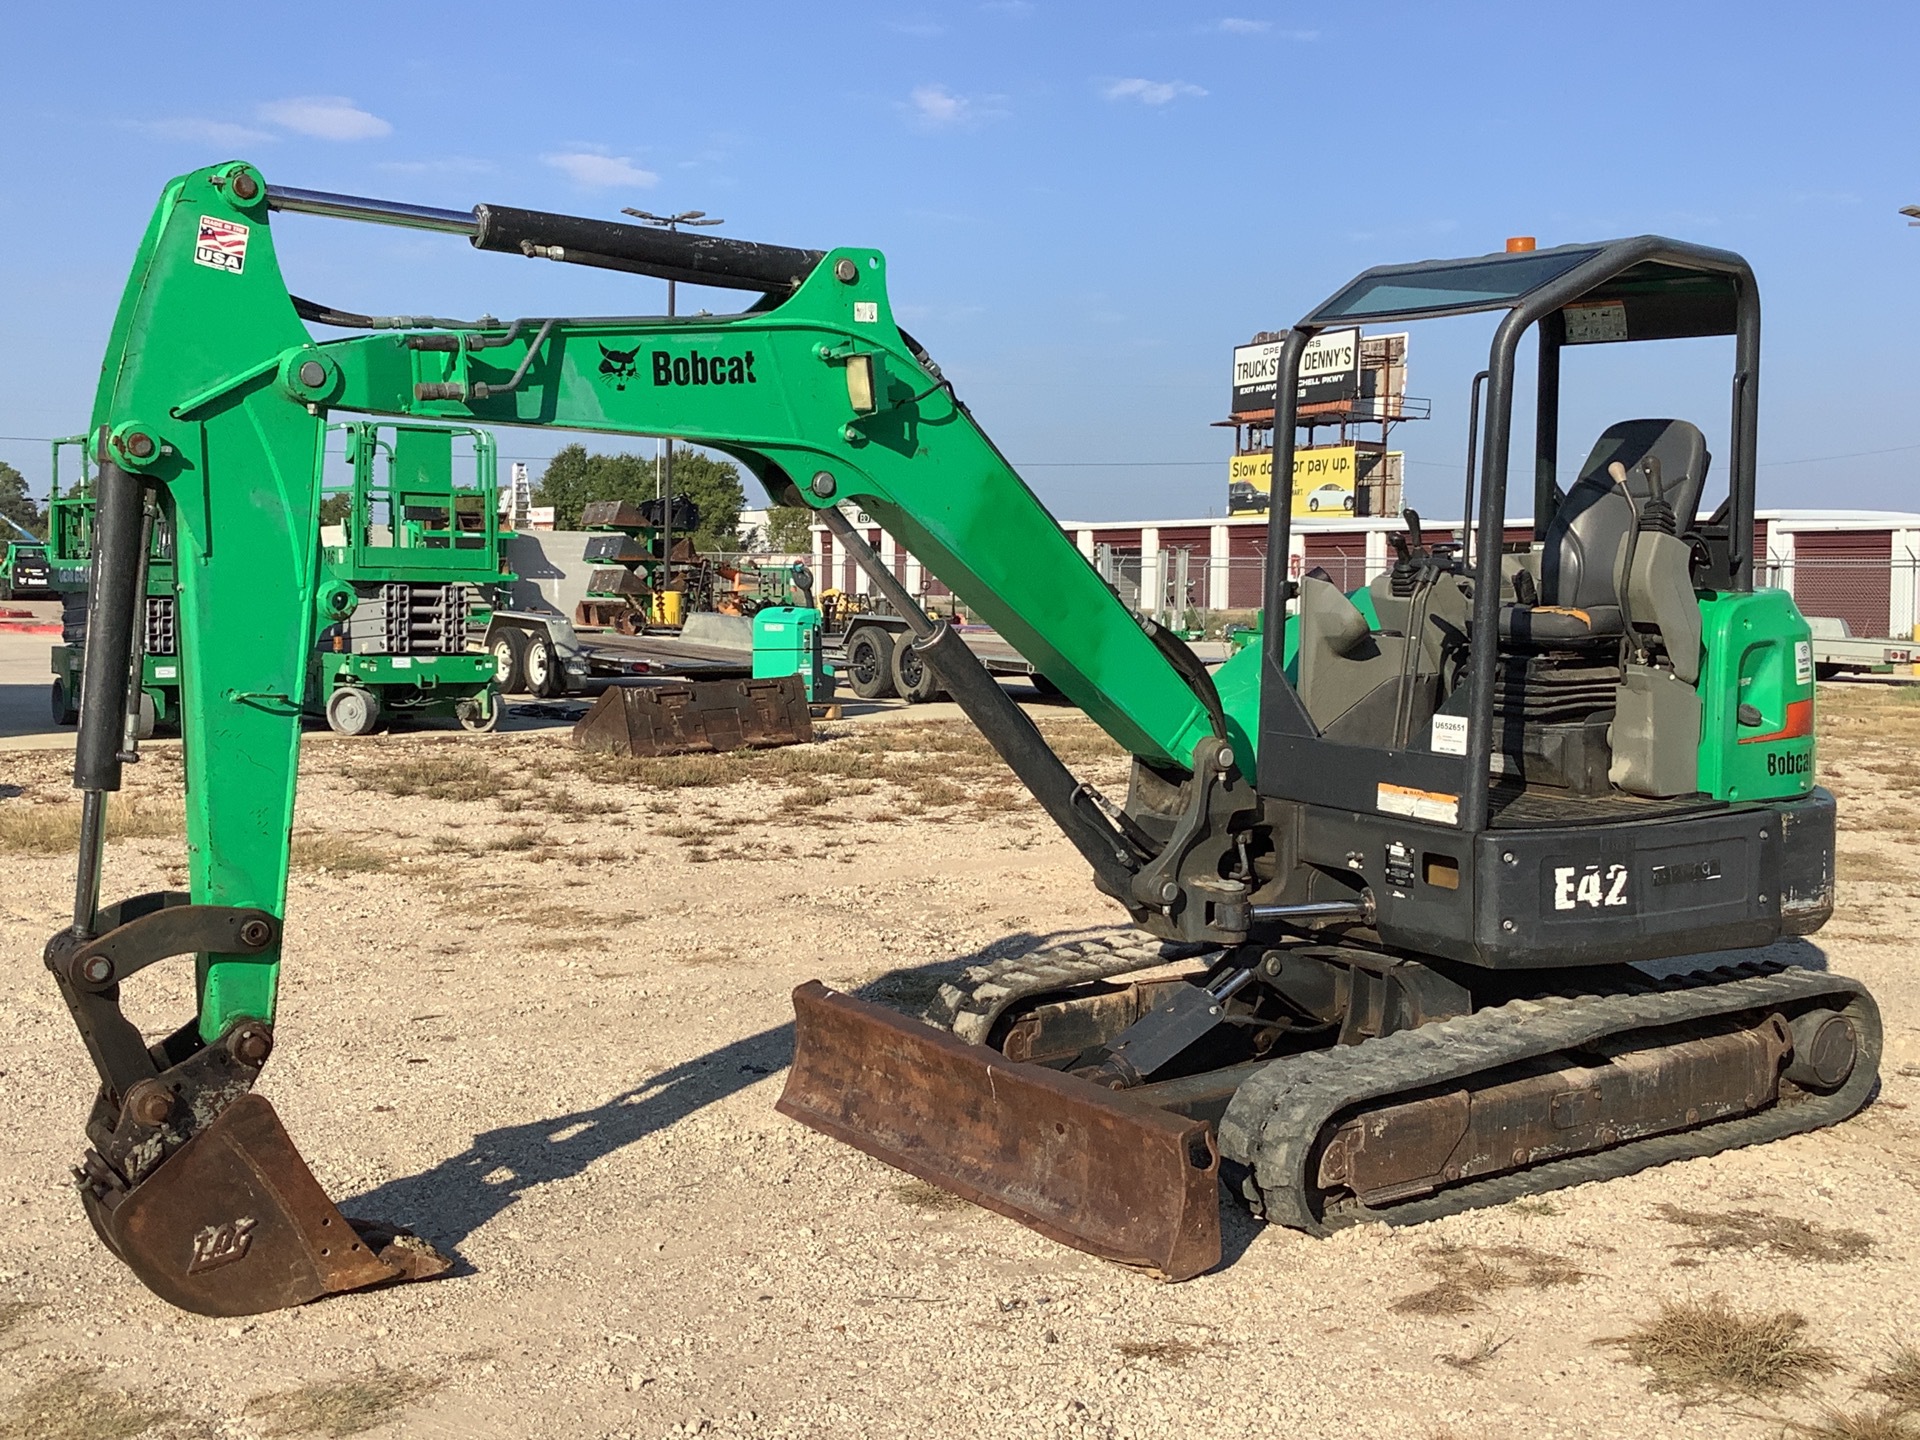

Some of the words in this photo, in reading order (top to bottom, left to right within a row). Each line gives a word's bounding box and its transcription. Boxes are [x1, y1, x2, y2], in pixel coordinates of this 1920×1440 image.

[198, 248, 240, 269] USA
[1263, 346, 1279, 355] OPE
[651, 350, 757, 387] Bobcat
[1237, 359, 1268, 380] TRUCK
[1304, 346, 1351, 371] DENNY'S
[1240, 386, 1254, 395] EXIT
[1256, 383, 1277, 392] HARV
[1322, 374, 1344, 384] PKWY
[1232, 461, 1257, 477] Slow
[1260, 460, 1272, 474] do
[1292, 460, 1304, 473] or
[1308, 459, 1329, 475] pay
[1332, 457, 1350, 474] up.
[1435, 721, 1465, 732] U652651
[1554, 864, 1628, 910] E42
